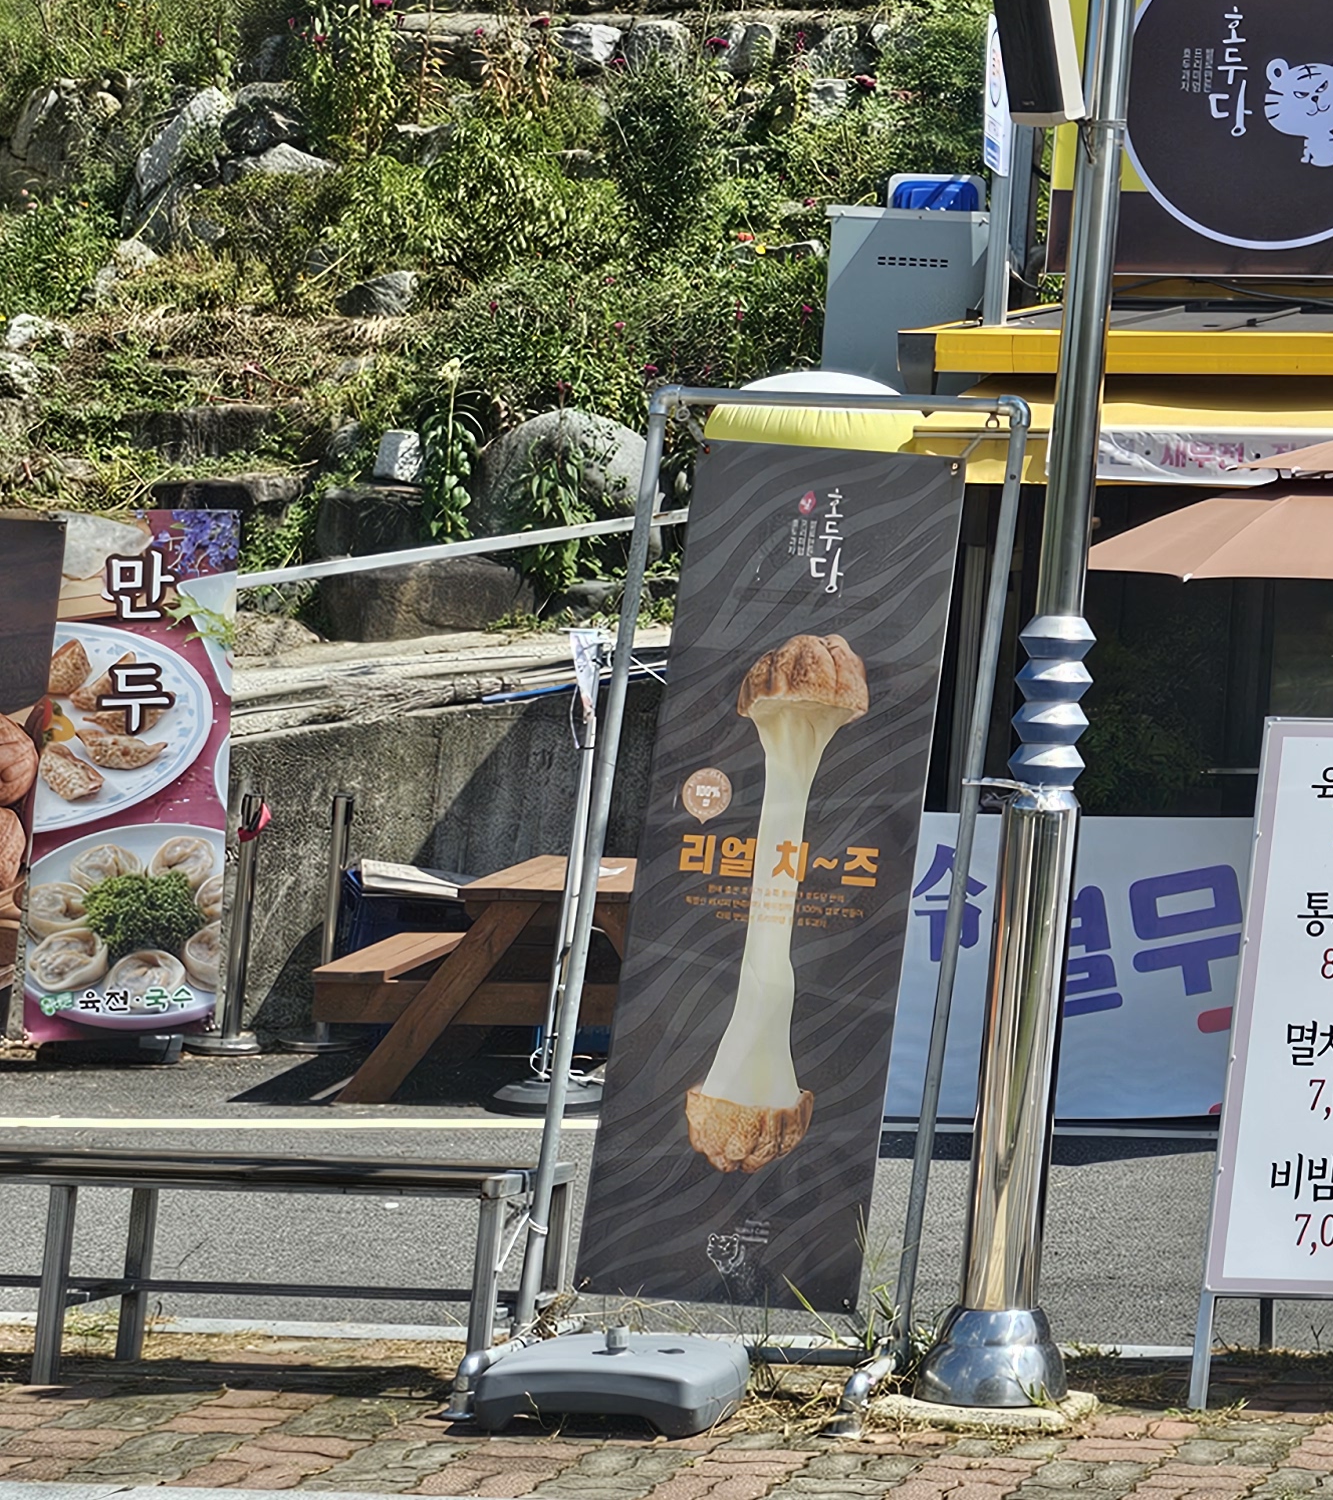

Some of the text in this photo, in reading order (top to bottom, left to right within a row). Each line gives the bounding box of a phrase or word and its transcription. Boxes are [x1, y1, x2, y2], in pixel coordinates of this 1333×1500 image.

[1208, 5, 1253, 137] 호두당
[809, 487, 844, 594] 호두당
[101, 550, 178, 735] 만두
[679, 835, 757, 878] 리얼
[78, 989, 130, 1013] 육전
[144, 984, 195, 1011] 국수
